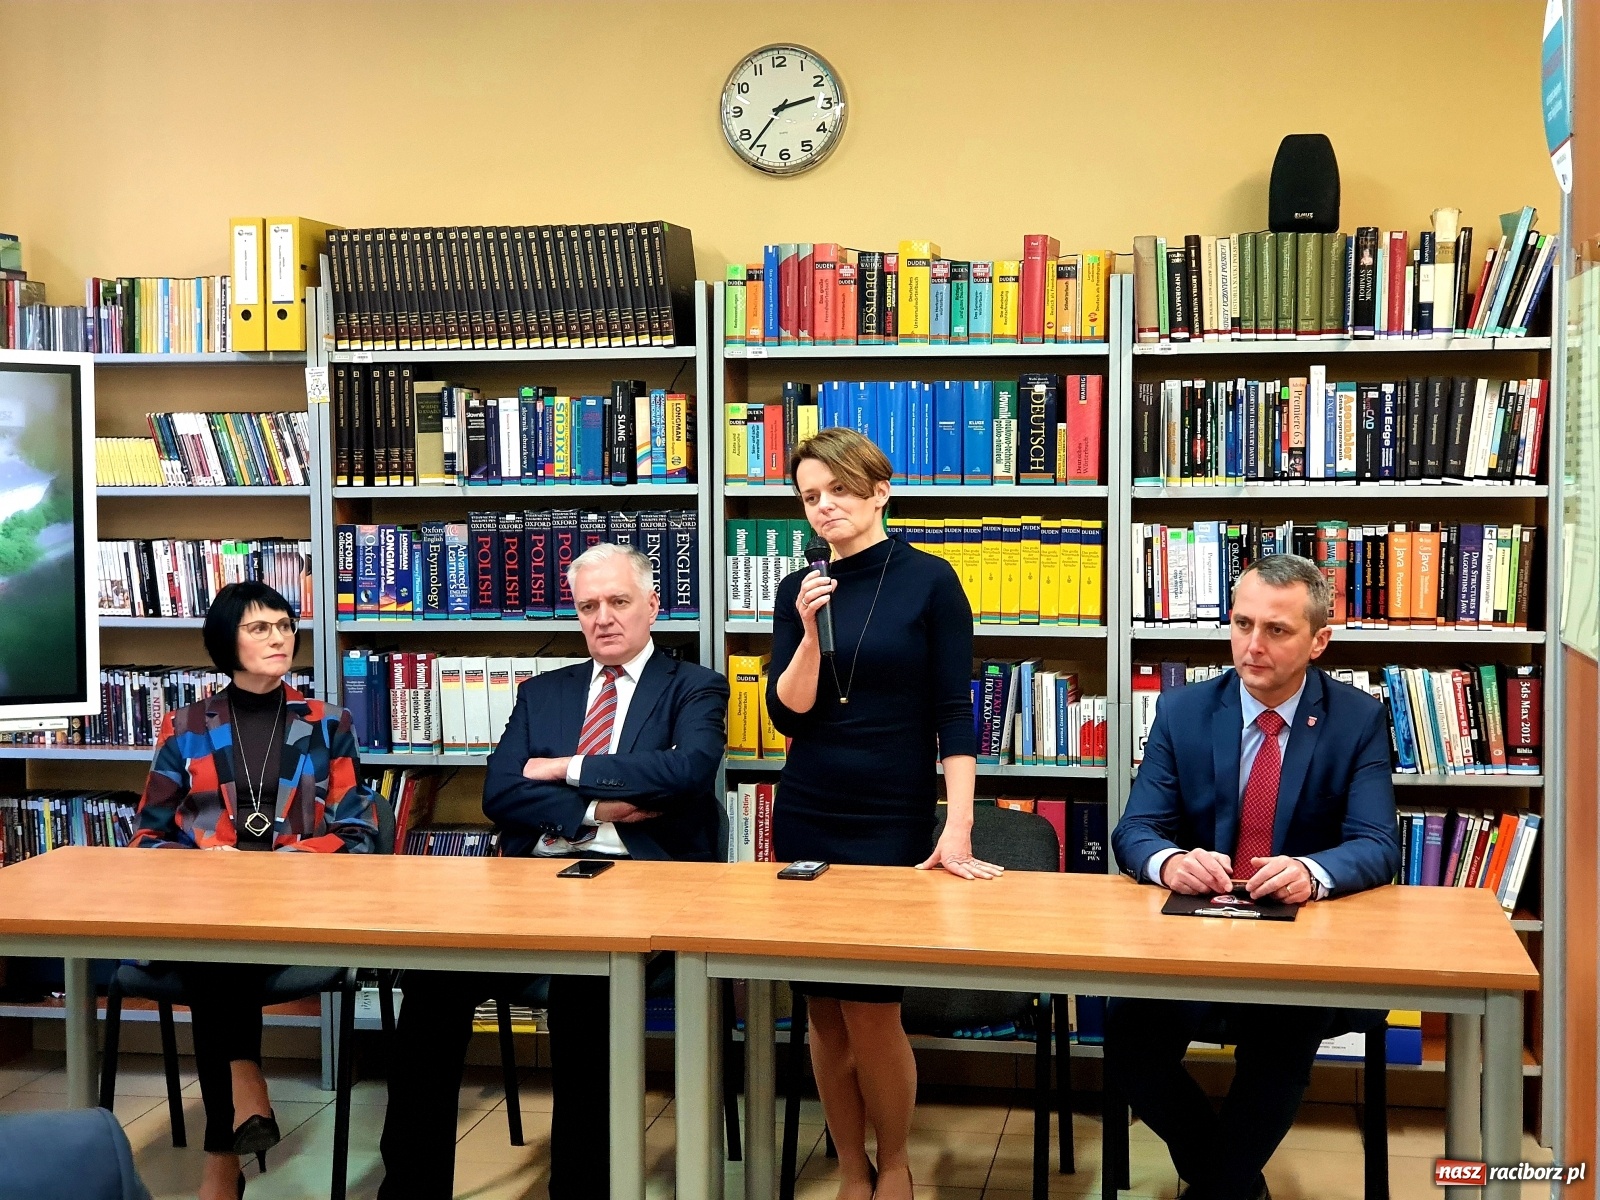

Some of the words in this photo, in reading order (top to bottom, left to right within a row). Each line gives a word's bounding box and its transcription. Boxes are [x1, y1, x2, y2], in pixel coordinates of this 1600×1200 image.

[754, 64, 762, 76] 11
[772, 56, 786, 68] 12
[800, 60, 804, 71] 1
[737, 82, 750, 94] 10
[812, 75, 824, 87] 2
[732, 106, 743, 118] 9
[820, 97, 832, 110] 3
[738, 129, 752, 140] 8
[816, 122, 828, 134] 4
[756, 144, 766, 157] 7
[779, 148, 790, 160] 6
[801, 140, 813, 152] 5
[866, 271, 876, 334] DEUTSCH
[1000, 391, 1011, 420] słownik
[1293, 390, 1302, 430] Premiere
[556, 402, 565, 473] LEXICUS
[618, 414, 626, 442] SLANG
[1030, 391, 1045, 471] DEUTSCH
[1293, 432, 1302, 444] 6.5
[1344, 394, 1354, 460] Asembler
[1383, 416, 1392, 446] Edge
[365, 535, 376, 576] Oxford
[736, 528, 748, 556] słownik
[766, 529, 778, 556] słownik
[793, 530, 804, 558] słownik
[386, 529, 394, 585] LONGMAN
[458, 544, 468, 589] Advanced
[478, 536, 492, 604] POLISH
[504, 537, 519, 605] POLISH
[531, 534, 544, 602] POLISH
[558, 532, 572, 601] POLISH
[677, 533, 690, 605] ENGLISH
[1232, 543, 1240, 574] ORACLE
[1394, 548, 1406, 568] Java
[1419, 552, 1432, 572] Java
[427, 544, 441, 609] Etymology
[743, 557, 751, 609] naukowo-techniczny
[1395, 572, 1403, 608] Podstawy
[394, 663, 405, 689] słownik
[416, 663, 428, 689] słownik
[1520, 682, 1530, 698] 3ds
[1456, 682, 1465, 719] Premiere
[1520, 700, 1530, 719] Max
[1520, 721, 1530, 743] 2012
[1468, 856, 1479, 885] Zarządzanie
